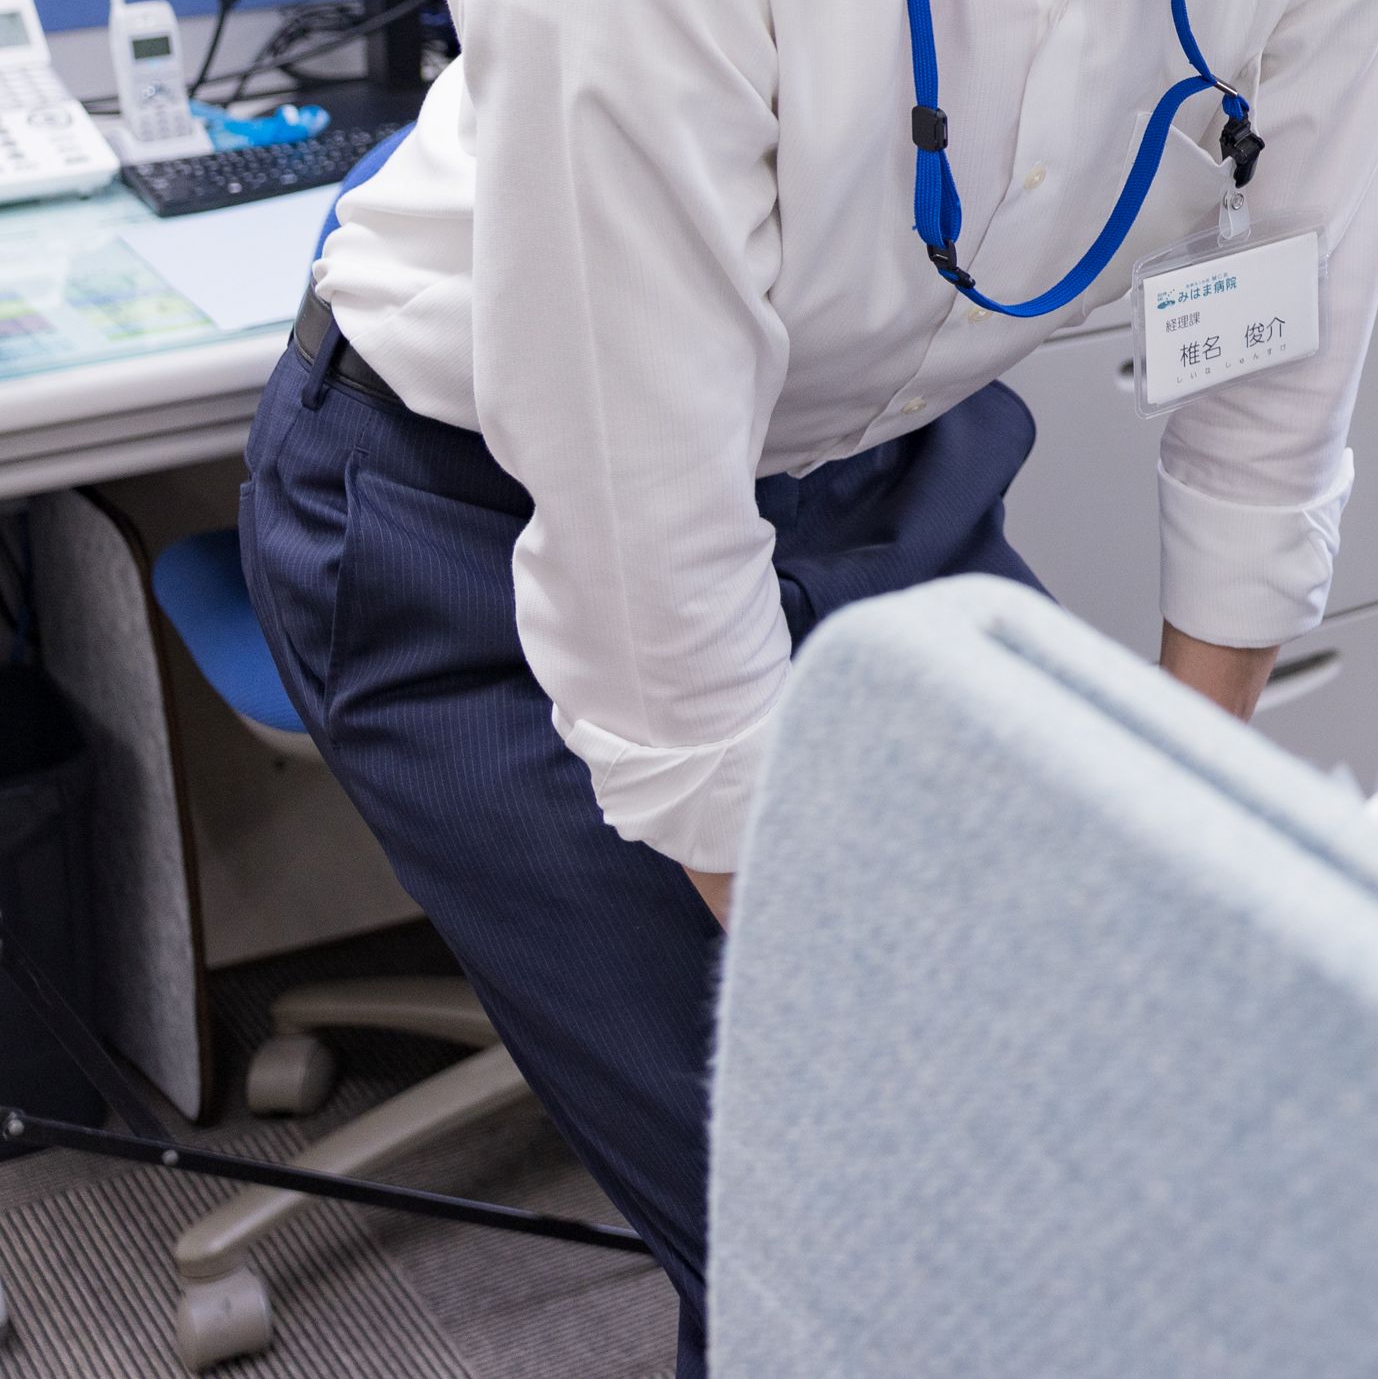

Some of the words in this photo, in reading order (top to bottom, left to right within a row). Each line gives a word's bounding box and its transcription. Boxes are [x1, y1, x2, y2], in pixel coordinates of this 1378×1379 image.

[1178, 276, 1237, 303] みはま病院
[1165, 311, 1201, 333] 経理課
[1179, 335, 1222, 368] 椎名
[1244, 316, 1286, 349] 俊介
